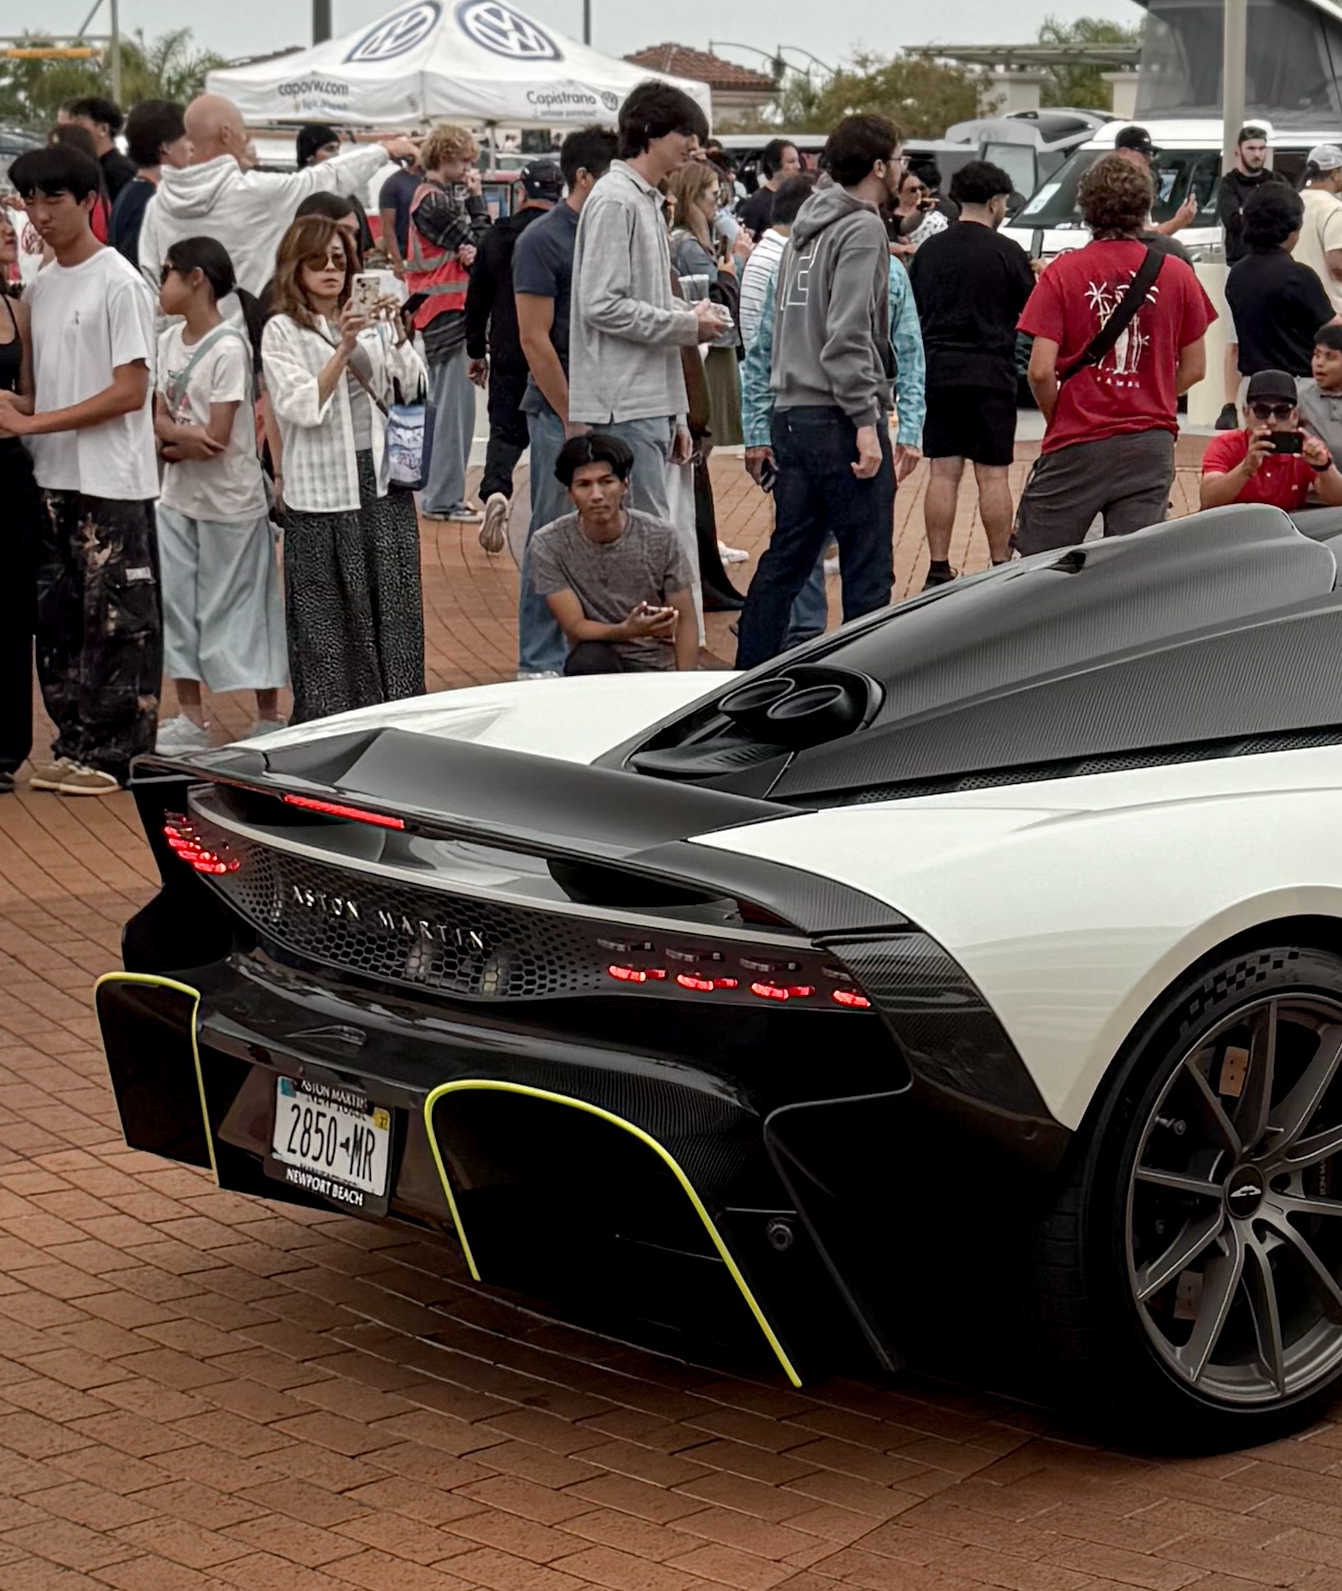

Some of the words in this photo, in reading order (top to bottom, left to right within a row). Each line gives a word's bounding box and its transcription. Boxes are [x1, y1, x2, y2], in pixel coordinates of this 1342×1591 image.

[278, 79, 349, 99] capovw.com
[526, 90, 597, 107] Capistrano
[293, 885, 361, 920] ASTON
[378, 909, 484, 950] MARTIN
[287, 1103, 338, 1167] 2850
[349, 1123, 375, 1183] MR
[285, 1167, 332, 1196] NEWPORT
[332, 1184, 363, 1207] BEACH
